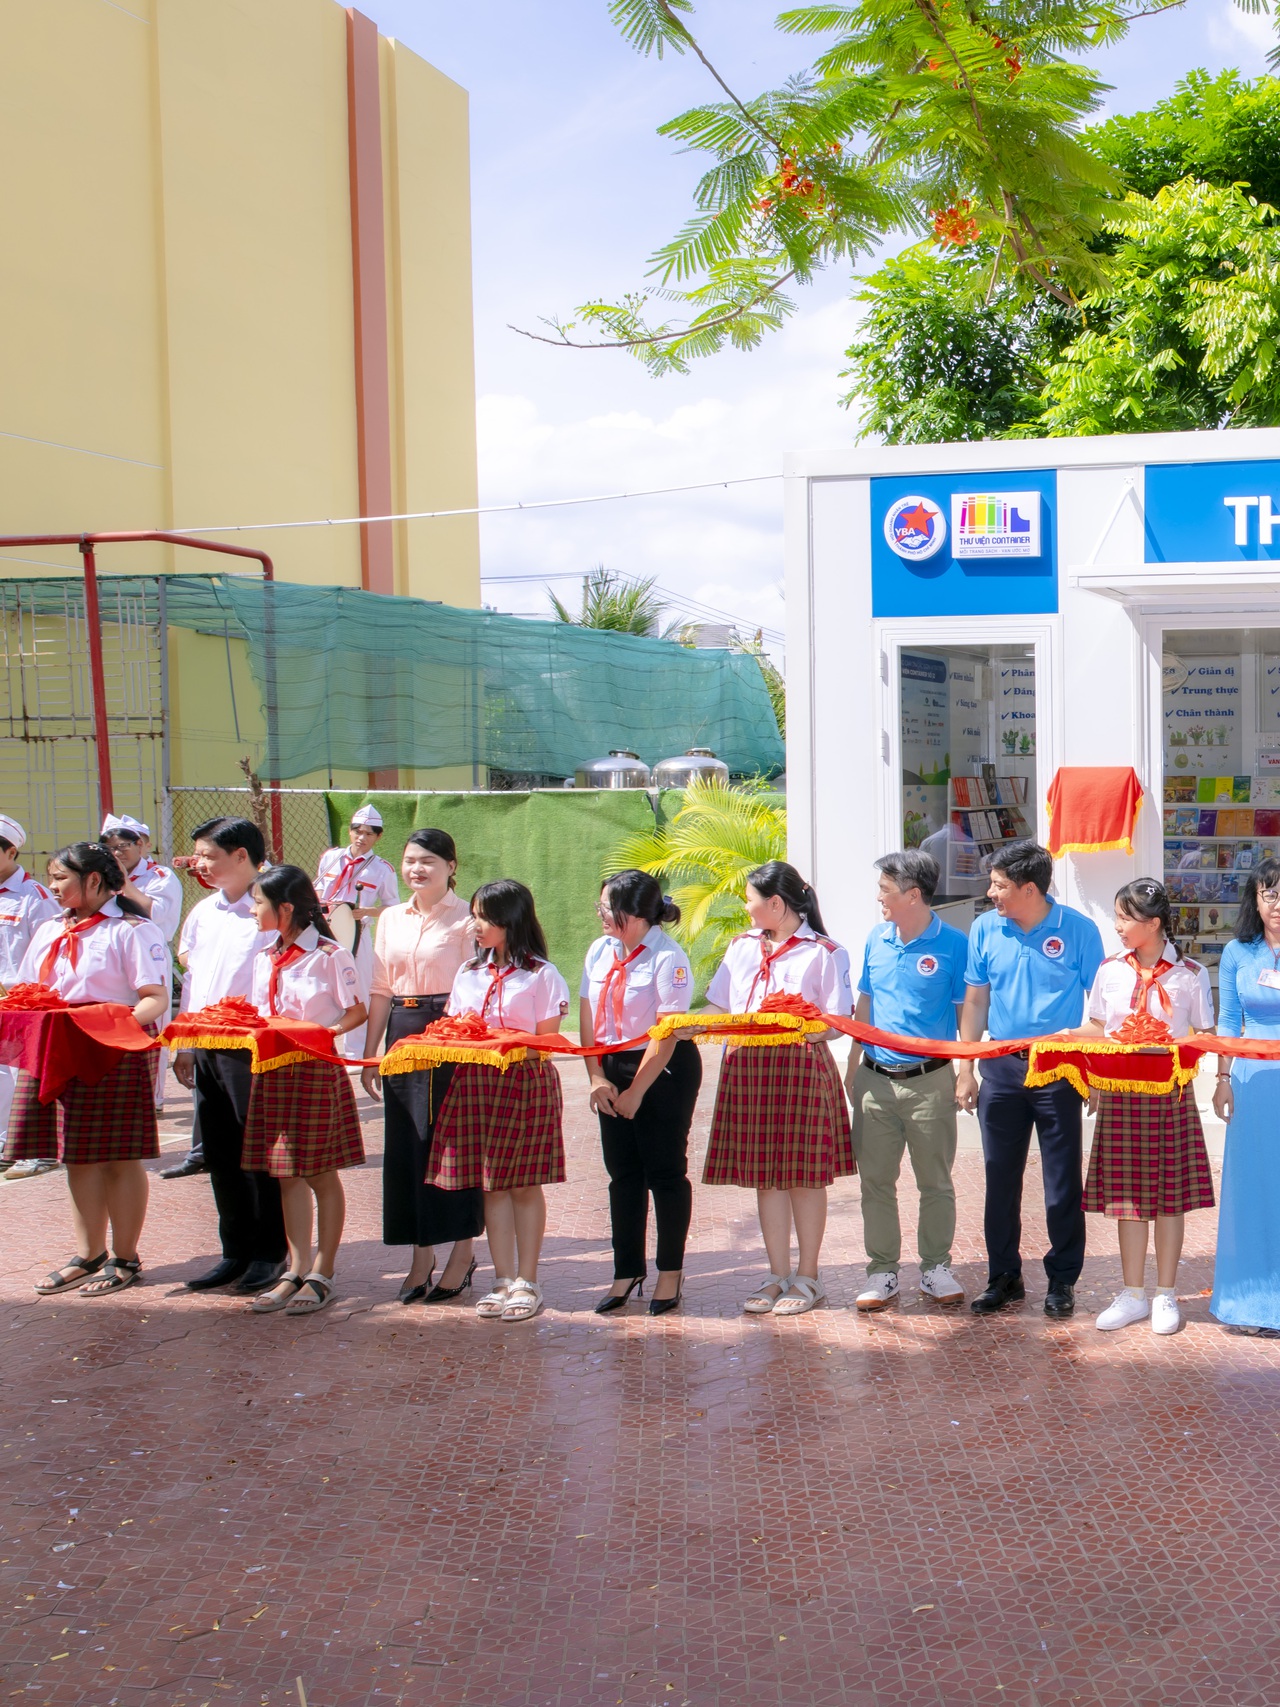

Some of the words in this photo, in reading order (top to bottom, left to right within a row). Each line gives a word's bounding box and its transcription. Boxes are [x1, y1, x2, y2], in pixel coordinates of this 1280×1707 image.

[895, 527, 916, 536] YBA
[960, 537, 974, 545] THƯ
[1198, 666, 1222, 675] Giản
[1224, 667, 1235, 676] dị
[1181, 687, 1213, 695] Trung
[1215, 686, 1239, 695] thực
[1176, 709, 1201, 717] Chân
[1204, 709, 1234, 717] thành
